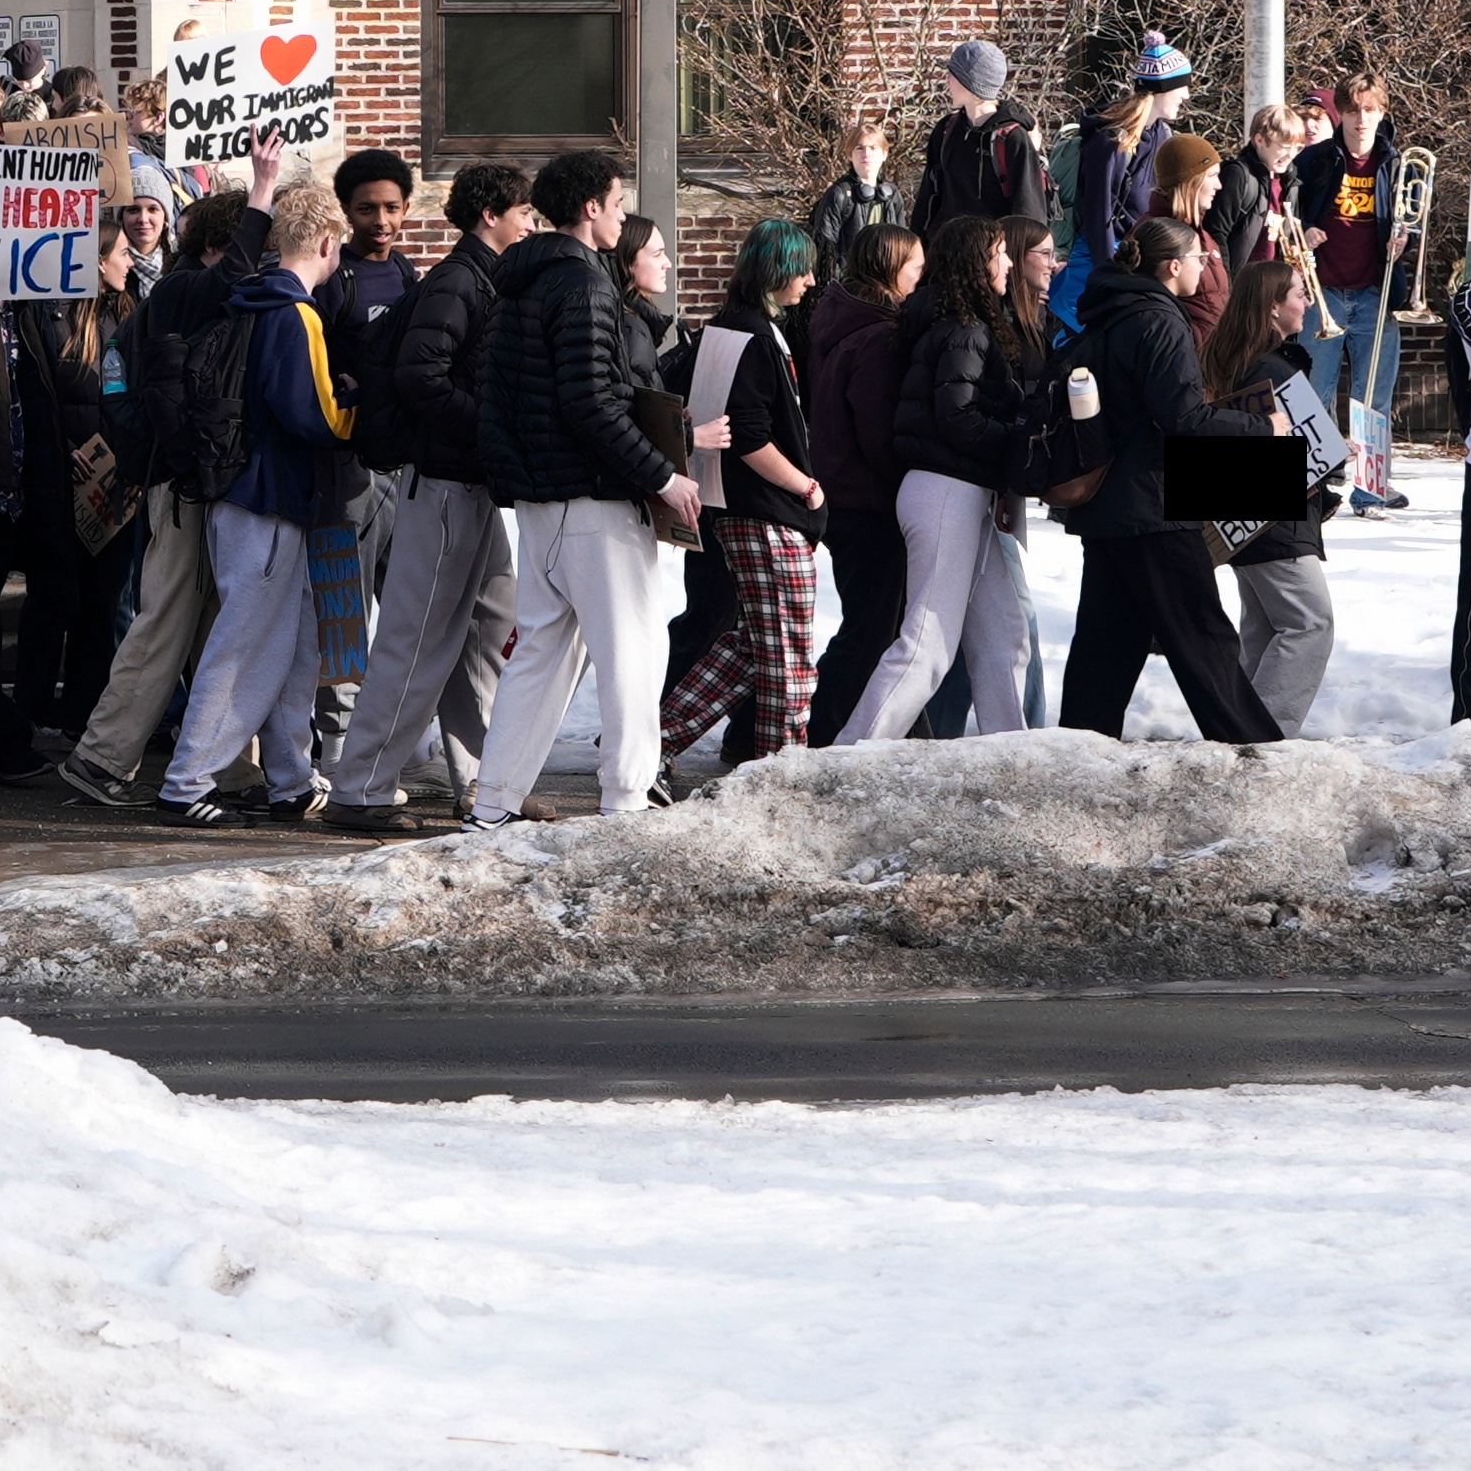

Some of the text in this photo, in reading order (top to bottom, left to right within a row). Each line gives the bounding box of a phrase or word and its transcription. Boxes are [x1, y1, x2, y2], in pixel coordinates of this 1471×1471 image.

[175, 45, 236, 87] WE
[169, 76, 335, 131] OUR IMMIGRANT
[23, 123, 118, 151] ABOLISH
[185, 106, 330, 162] NEIGBORS
[31, 150, 99, 183] HUMAN
[1, 185, 99, 229] HEART
[9, 231, 90, 296] ICE
[1353, 406, 1387, 449] MELT
[1353, 443, 1385, 497] ICE
